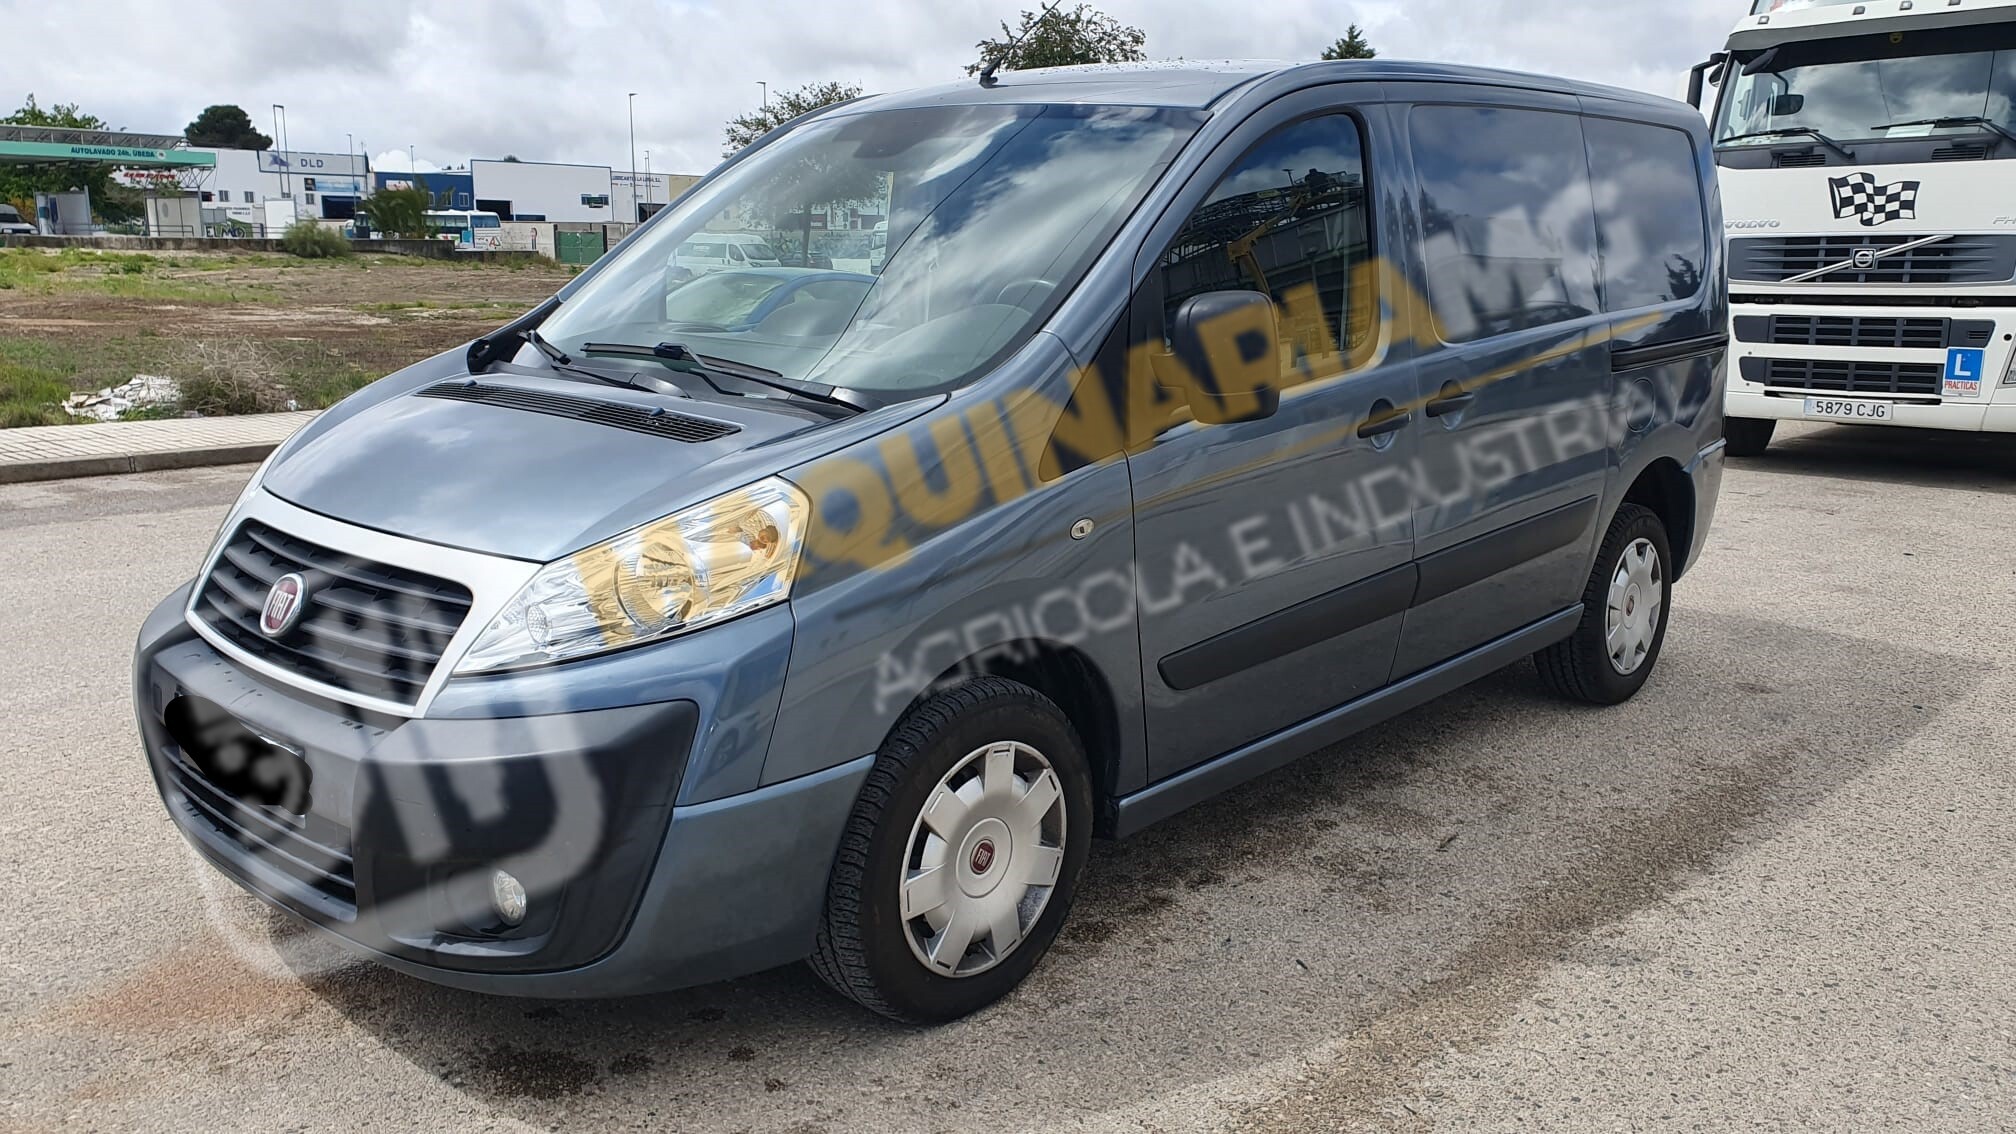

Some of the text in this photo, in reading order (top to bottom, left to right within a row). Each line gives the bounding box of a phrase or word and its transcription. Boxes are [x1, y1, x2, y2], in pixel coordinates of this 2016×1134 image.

[71, 146, 115, 156] AUTOLAVADO
[300, 158, 324, 168] DLD
[1725, 219, 1781, 229] VOLVO
[1954, 353, 1971, 376] L
[1816, 401, 1885, 417] 5879 CJG
[267, 589, 296, 621] FIAT
[975, 848, 991, 867] FIAT
